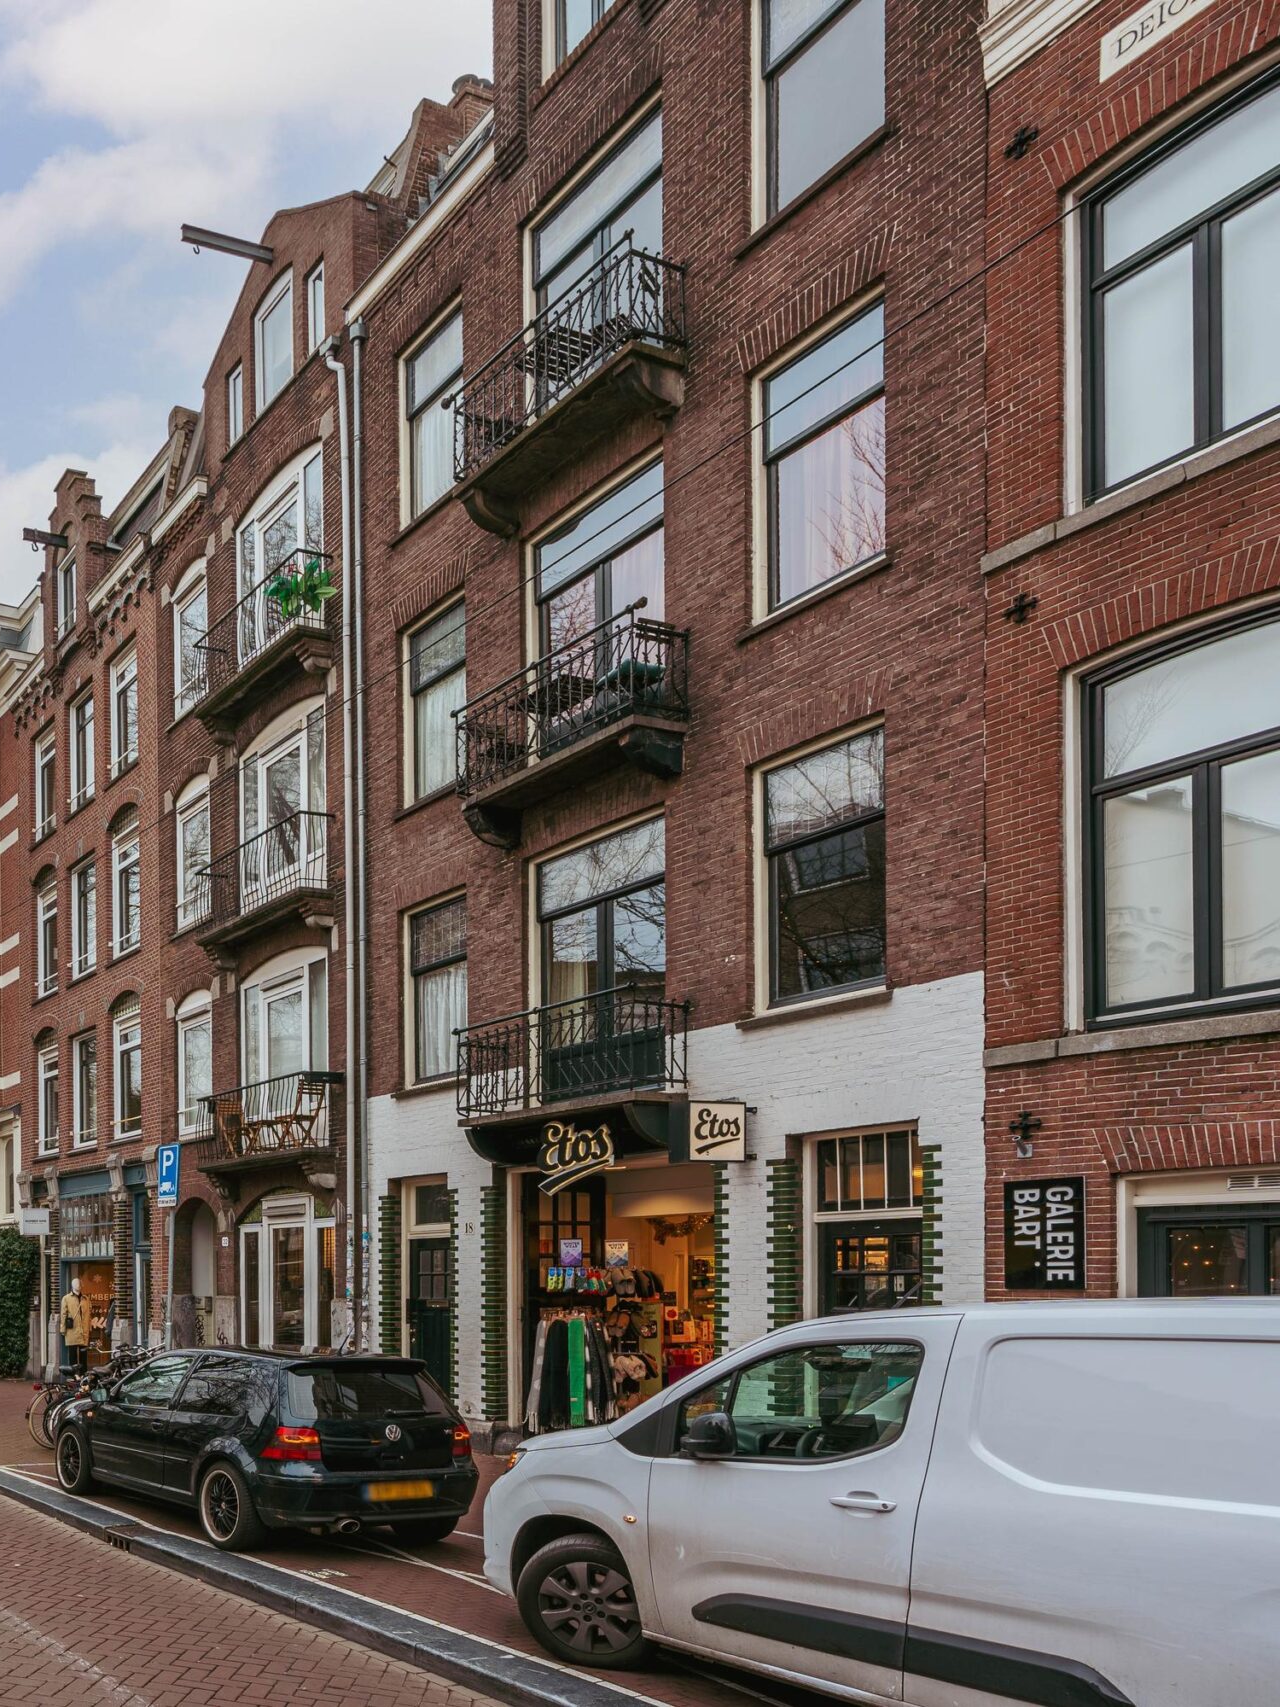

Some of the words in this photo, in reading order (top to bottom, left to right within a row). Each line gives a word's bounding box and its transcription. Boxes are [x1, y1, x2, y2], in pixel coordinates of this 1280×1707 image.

[694, 1108, 741, 1140] Etos
[162, 1150, 174, 1176] P
[536, 1120, 613, 1175] Etos
[465, 1222, 473, 1233] 18
[1014, 1188, 1040, 1249] BART
[1046, 1186, 1074, 1281] GALERIE
